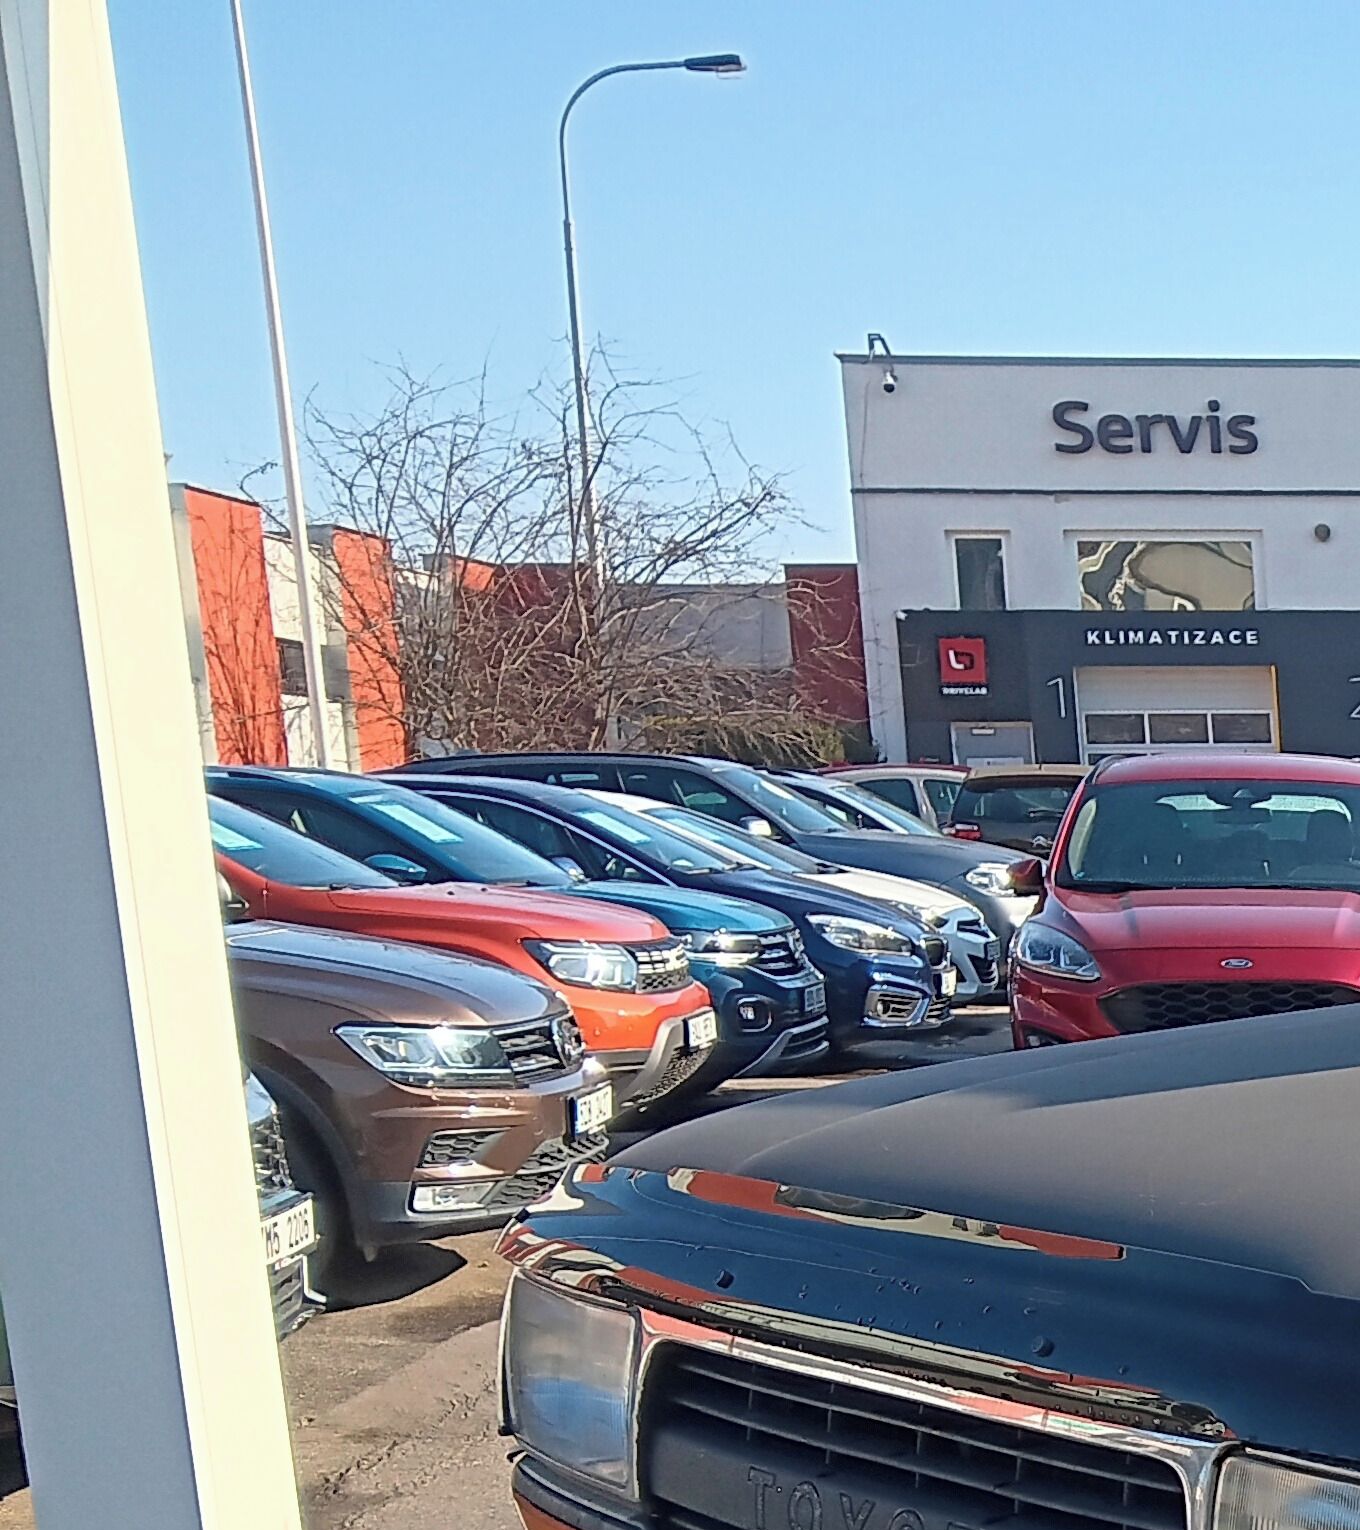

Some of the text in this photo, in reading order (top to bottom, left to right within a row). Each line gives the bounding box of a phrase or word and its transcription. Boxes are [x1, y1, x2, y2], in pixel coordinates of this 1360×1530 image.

[1052, 400, 1259, 455] Servis
[1086, 629, 1259, 646] KLIMATIZACE
[1046, 676, 1066, 719] 1
